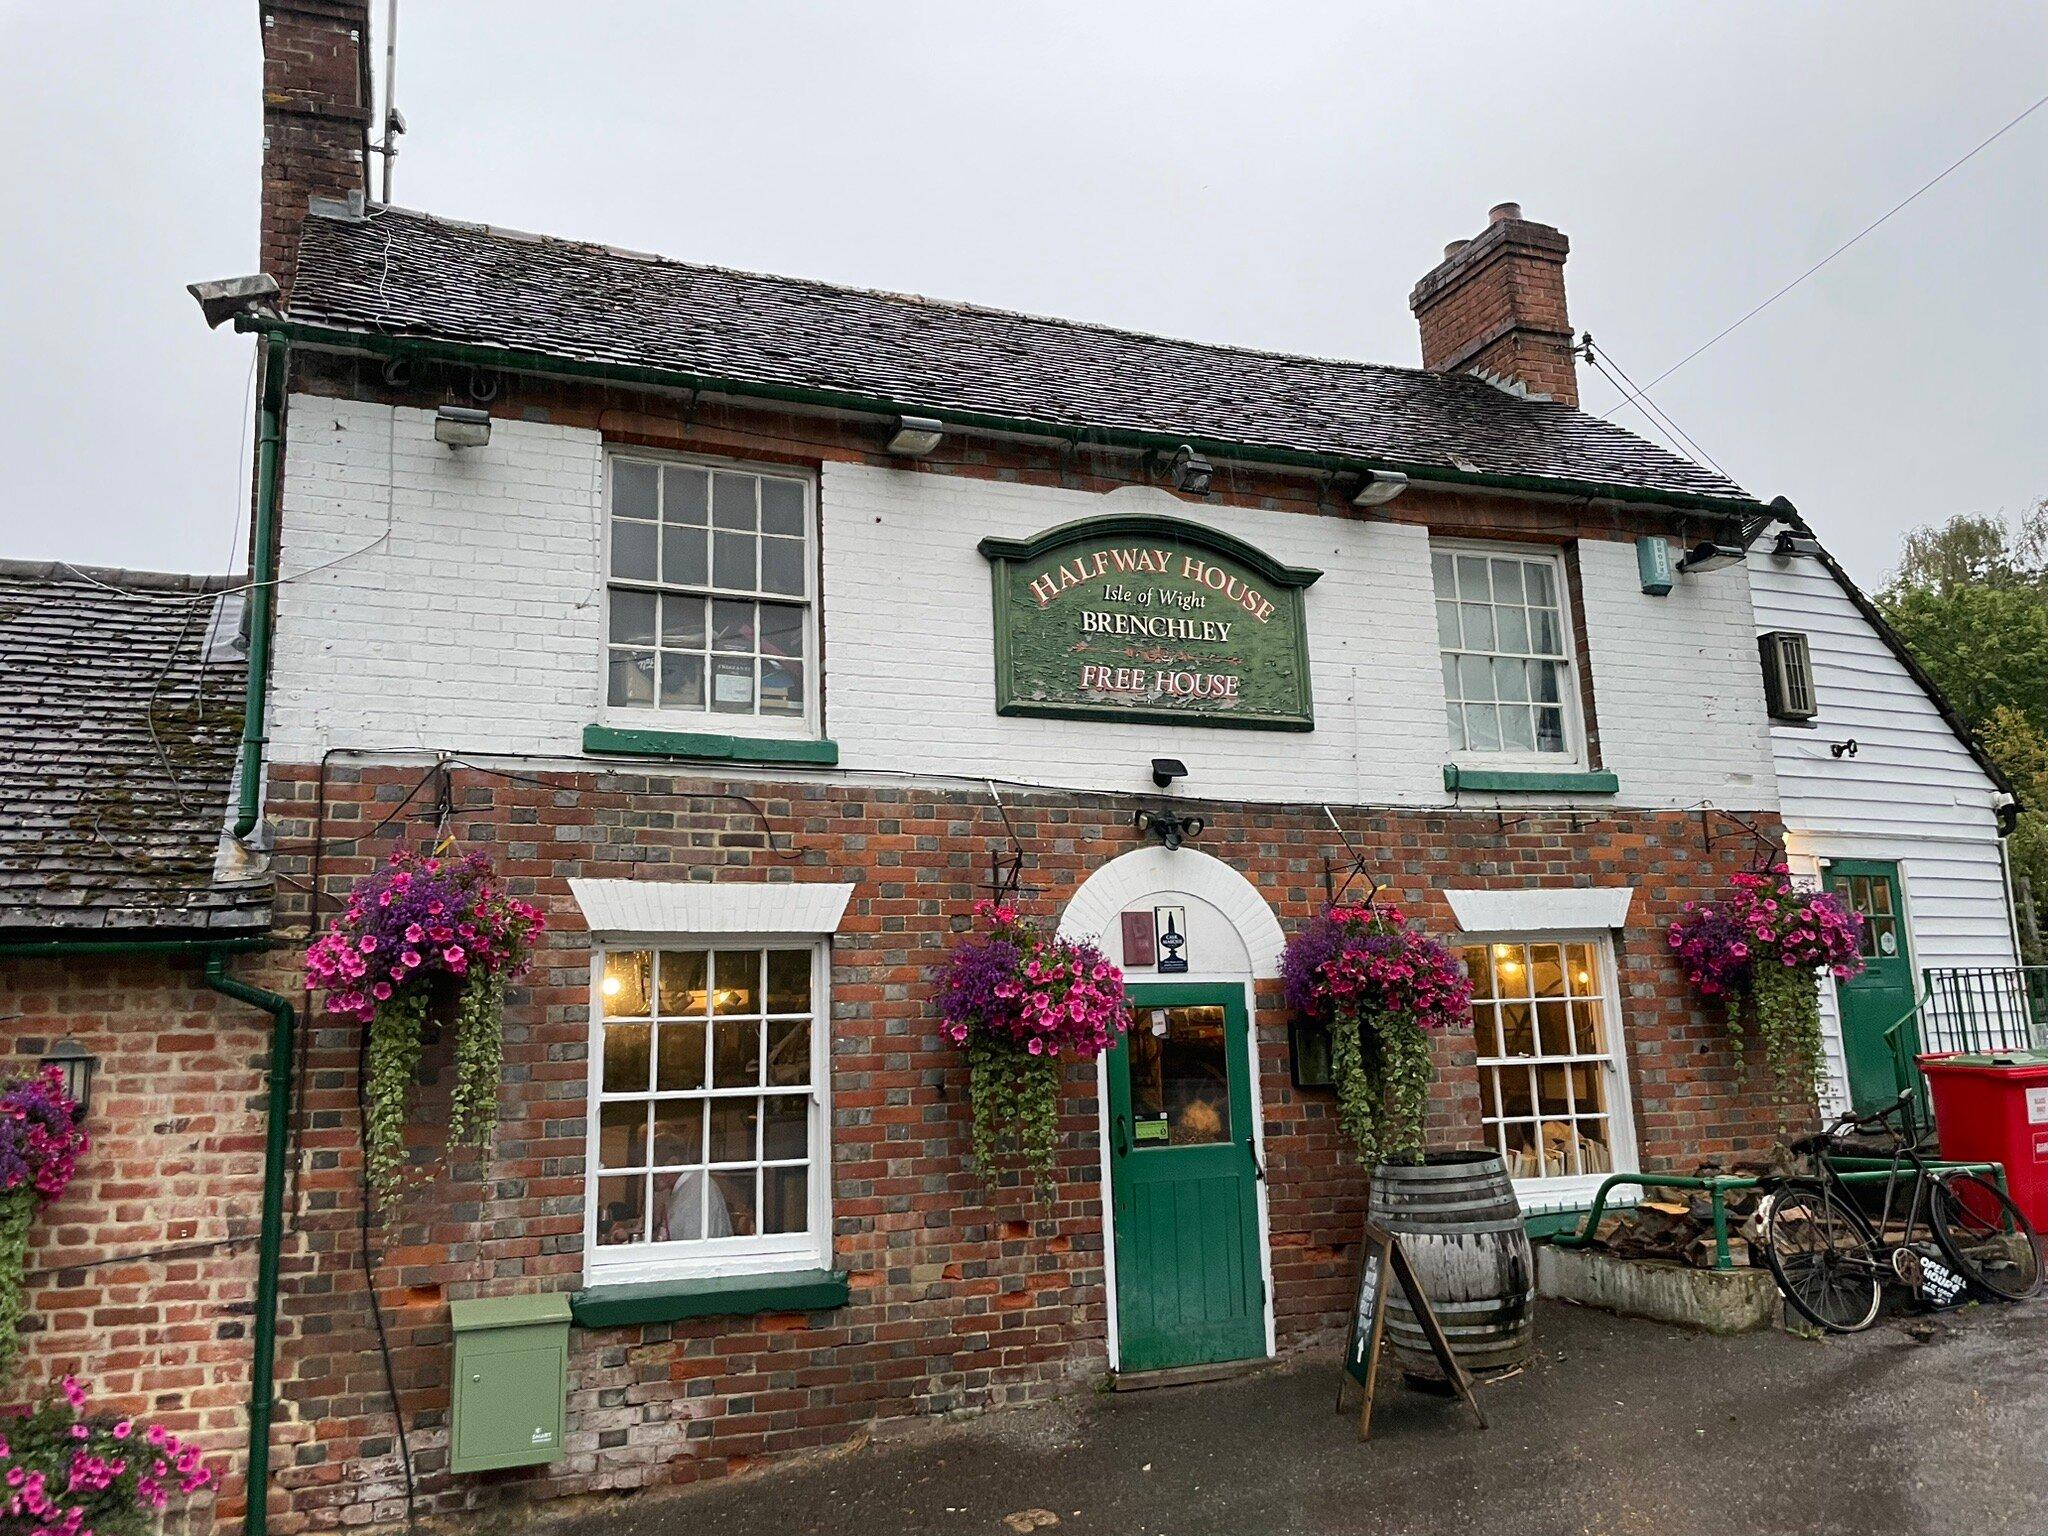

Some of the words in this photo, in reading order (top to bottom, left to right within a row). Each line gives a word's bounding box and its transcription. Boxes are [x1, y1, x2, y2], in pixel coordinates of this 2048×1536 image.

[1030, 548, 1173, 605] HALFWAY
[1181, 556, 1275, 624] HOUSE
[1103, 584, 1132, 601] Isle
[1137, 587, 1154, 606] of
[1158, 588, 1206, 611] Wight
[1081, 611, 1232, 642] BRENCHLEY
[1080, 665, 1146, 691] FREE
[1155, 670, 1239, 698] HOUSE
[1920, 1256, 1949, 1278] OPEN
[1950, 1274, 1967, 1289] ALL
[1923, 1267, 1960, 1293] HOURS
